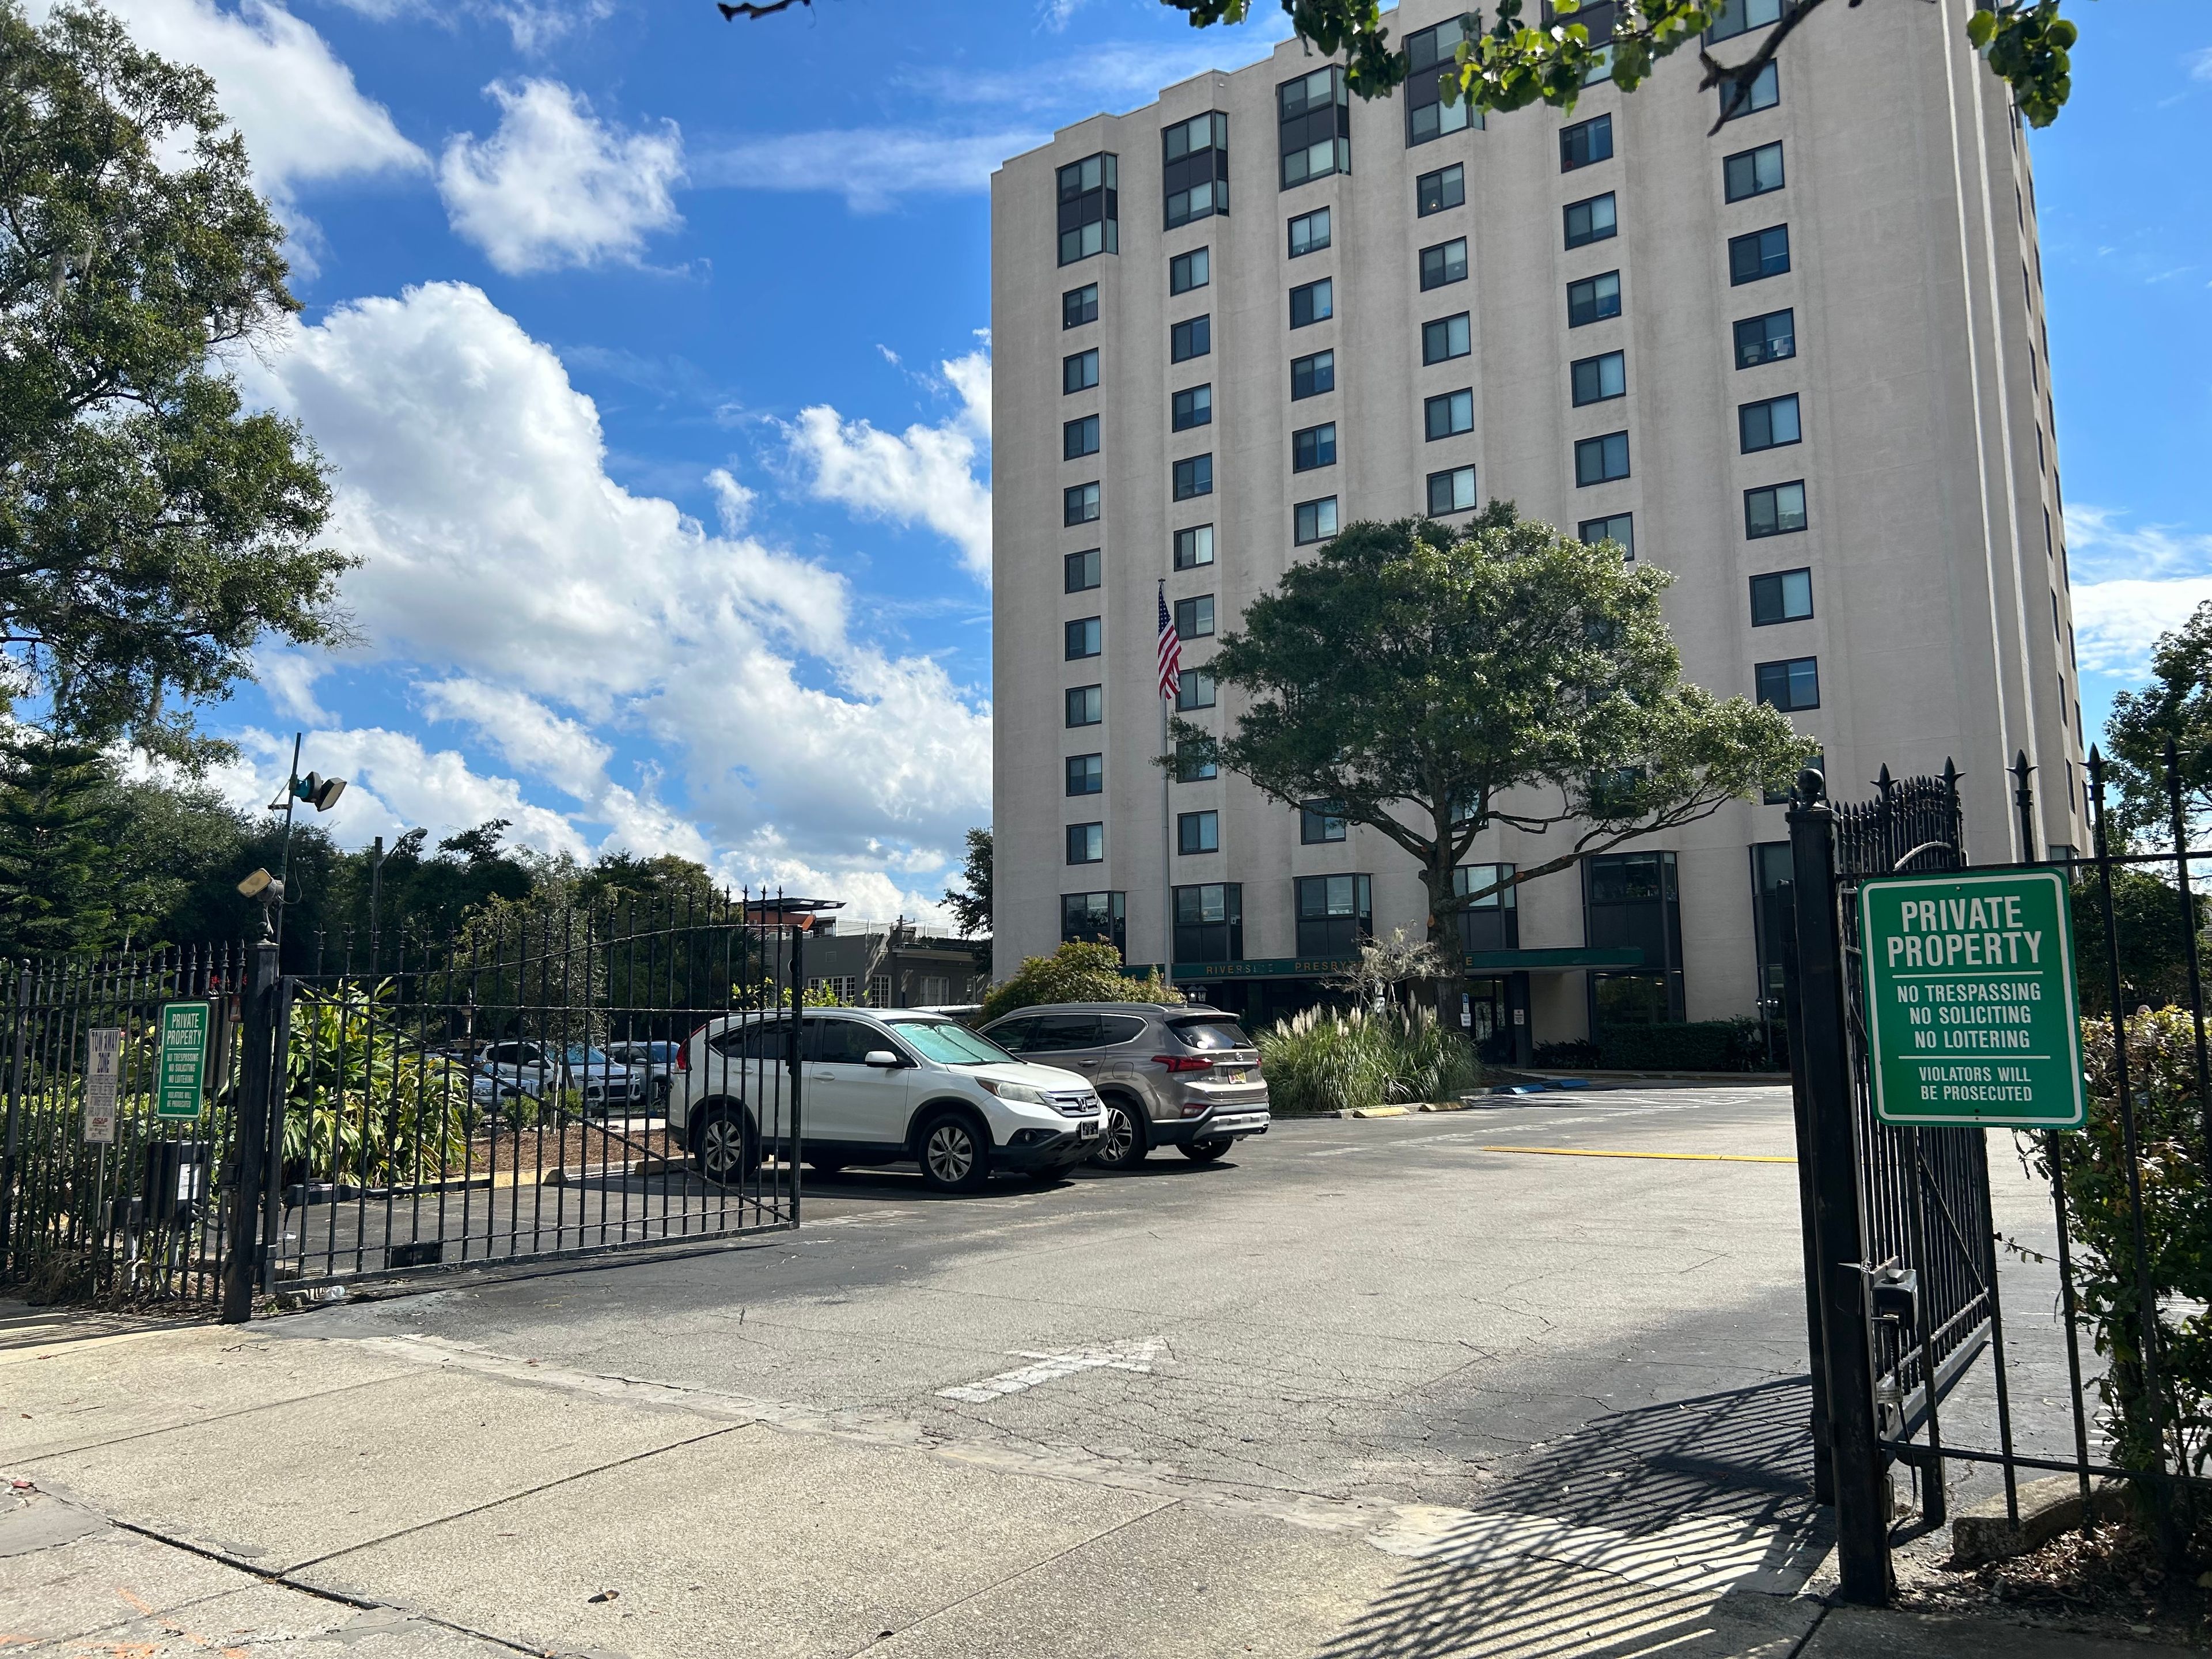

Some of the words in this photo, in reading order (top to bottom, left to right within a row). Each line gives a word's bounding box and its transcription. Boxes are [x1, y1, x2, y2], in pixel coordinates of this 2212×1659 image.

[1902, 896, 2023, 932] PRIVATE
[1887, 931, 2041, 967] PROPERTY
[1206, 964, 1274, 974] RIVERSIE
[1897, 985, 1919, 1002] NO
[1925, 983, 2041, 1002] TRESPASSING
[172, 1013, 199, 1028] PRIVATE
[1910, 1007, 1931, 1024] NO
[1939, 1006, 2031, 1024] SOLICITING
[92, 1031, 103, 1052] TOW
[166, 1029, 202, 1045] PROPERTY
[1915, 1031, 1937, 1048] NO
[1944, 1030, 2030, 1048] LOITERING
[167, 1053, 172, 1062] NO
[168, 1063, 174, 1072] NO
[1918, 1066, 1992, 1082] VIOLATORS
[1998, 1067, 2031, 1082] WILL
[168, 1075, 174, 1083] NO
[1921, 1085, 1938, 1100] BE
[1943, 1085, 2032, 1101] PROSECUTED
